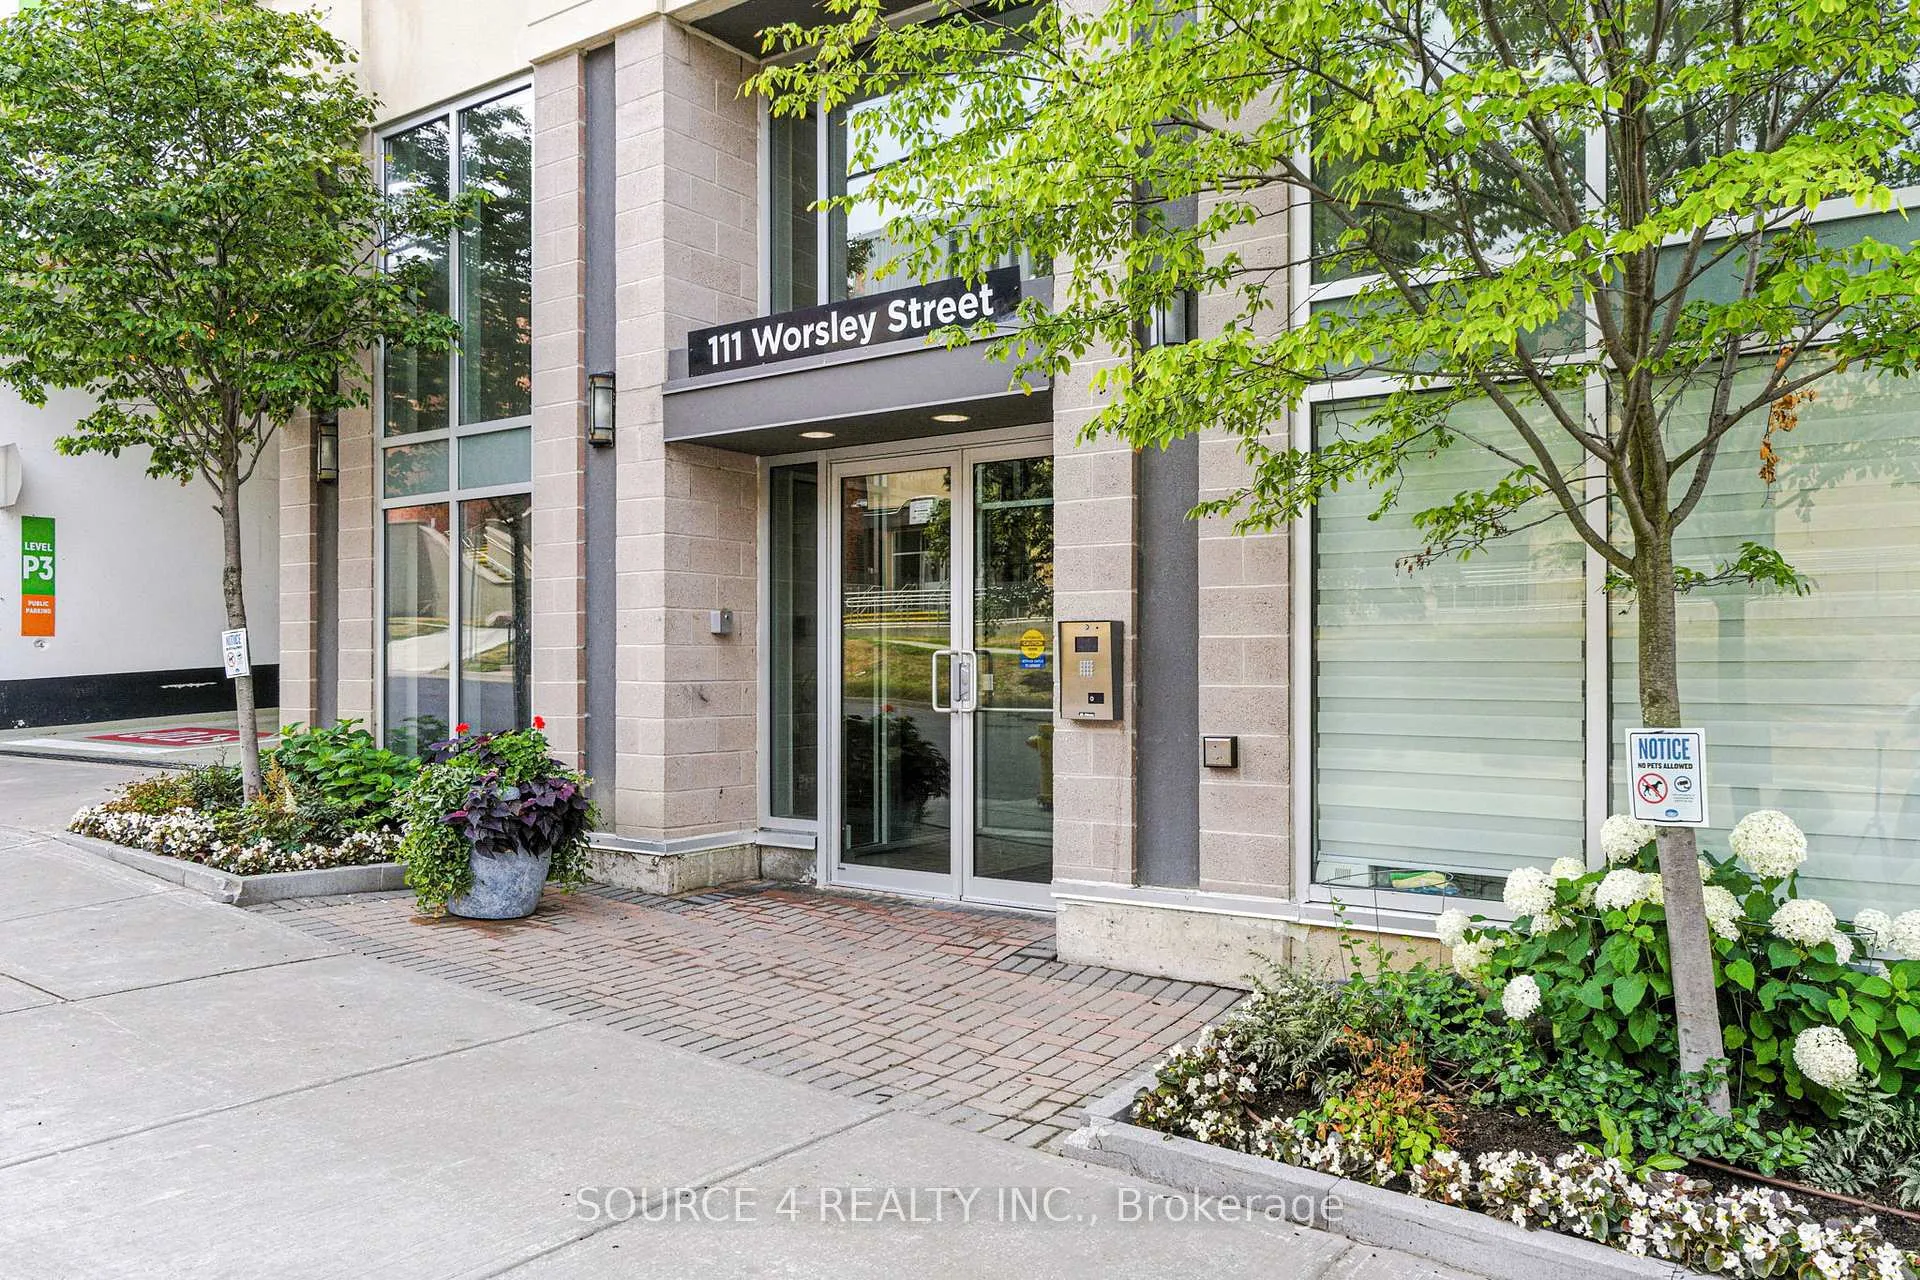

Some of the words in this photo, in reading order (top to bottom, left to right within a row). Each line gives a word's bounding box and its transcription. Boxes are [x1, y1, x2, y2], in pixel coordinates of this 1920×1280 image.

[708, 331, 742, 365] 111
[751, 311, 878, 357] Worsley
[887, 284, 995, 333] Street
[25, 541, 53, 552] LEVEL
[23, 555, 54, 580] P3
[1638, 737, 1691, 760] NOTICE
